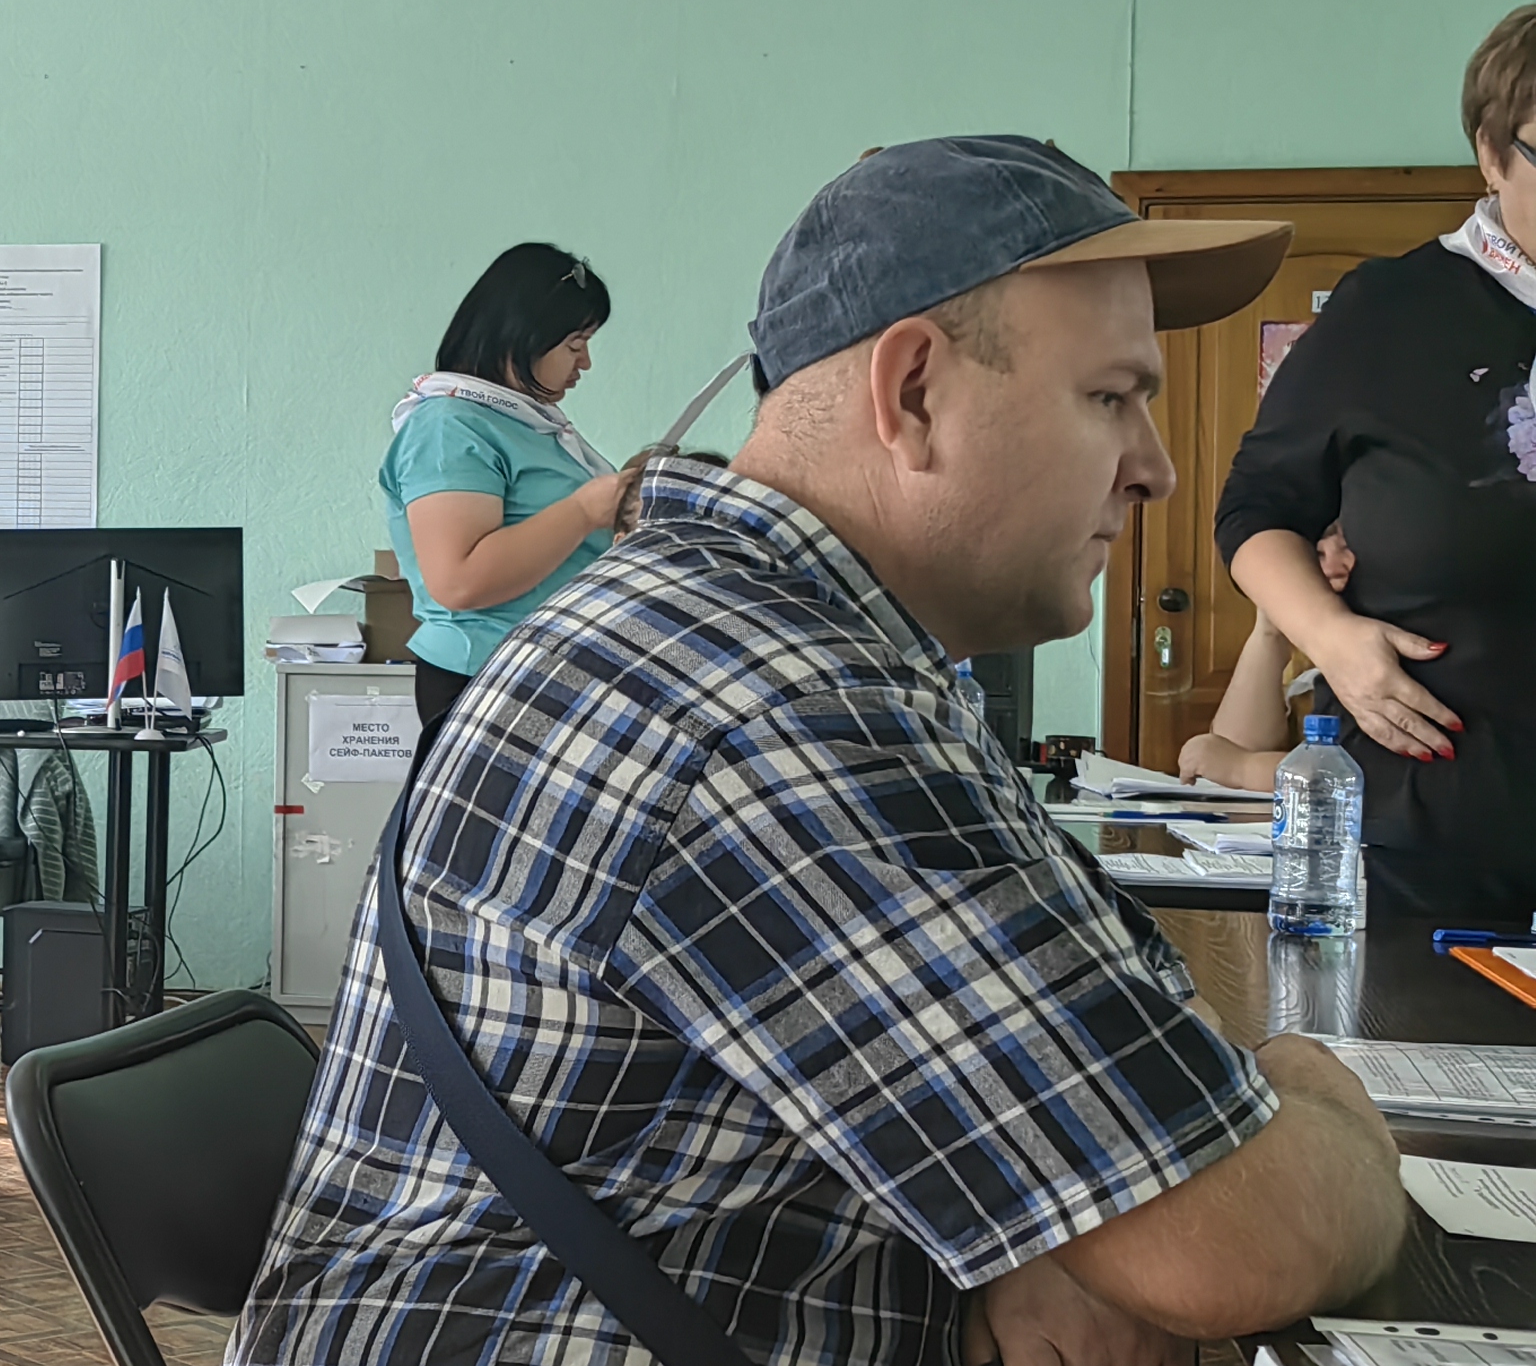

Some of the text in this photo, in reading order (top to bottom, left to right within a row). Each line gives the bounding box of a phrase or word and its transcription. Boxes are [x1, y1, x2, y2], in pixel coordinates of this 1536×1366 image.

[460, 388, 519, 410] ТВОЙ ГОЛОС
[352, 722, 390, 733] МЕСТО
[342, 735, 400, 746] ХРАНЕНИЯ
[328, 747, 412, 758] СЕЙФ-ПАКЕТОВ
